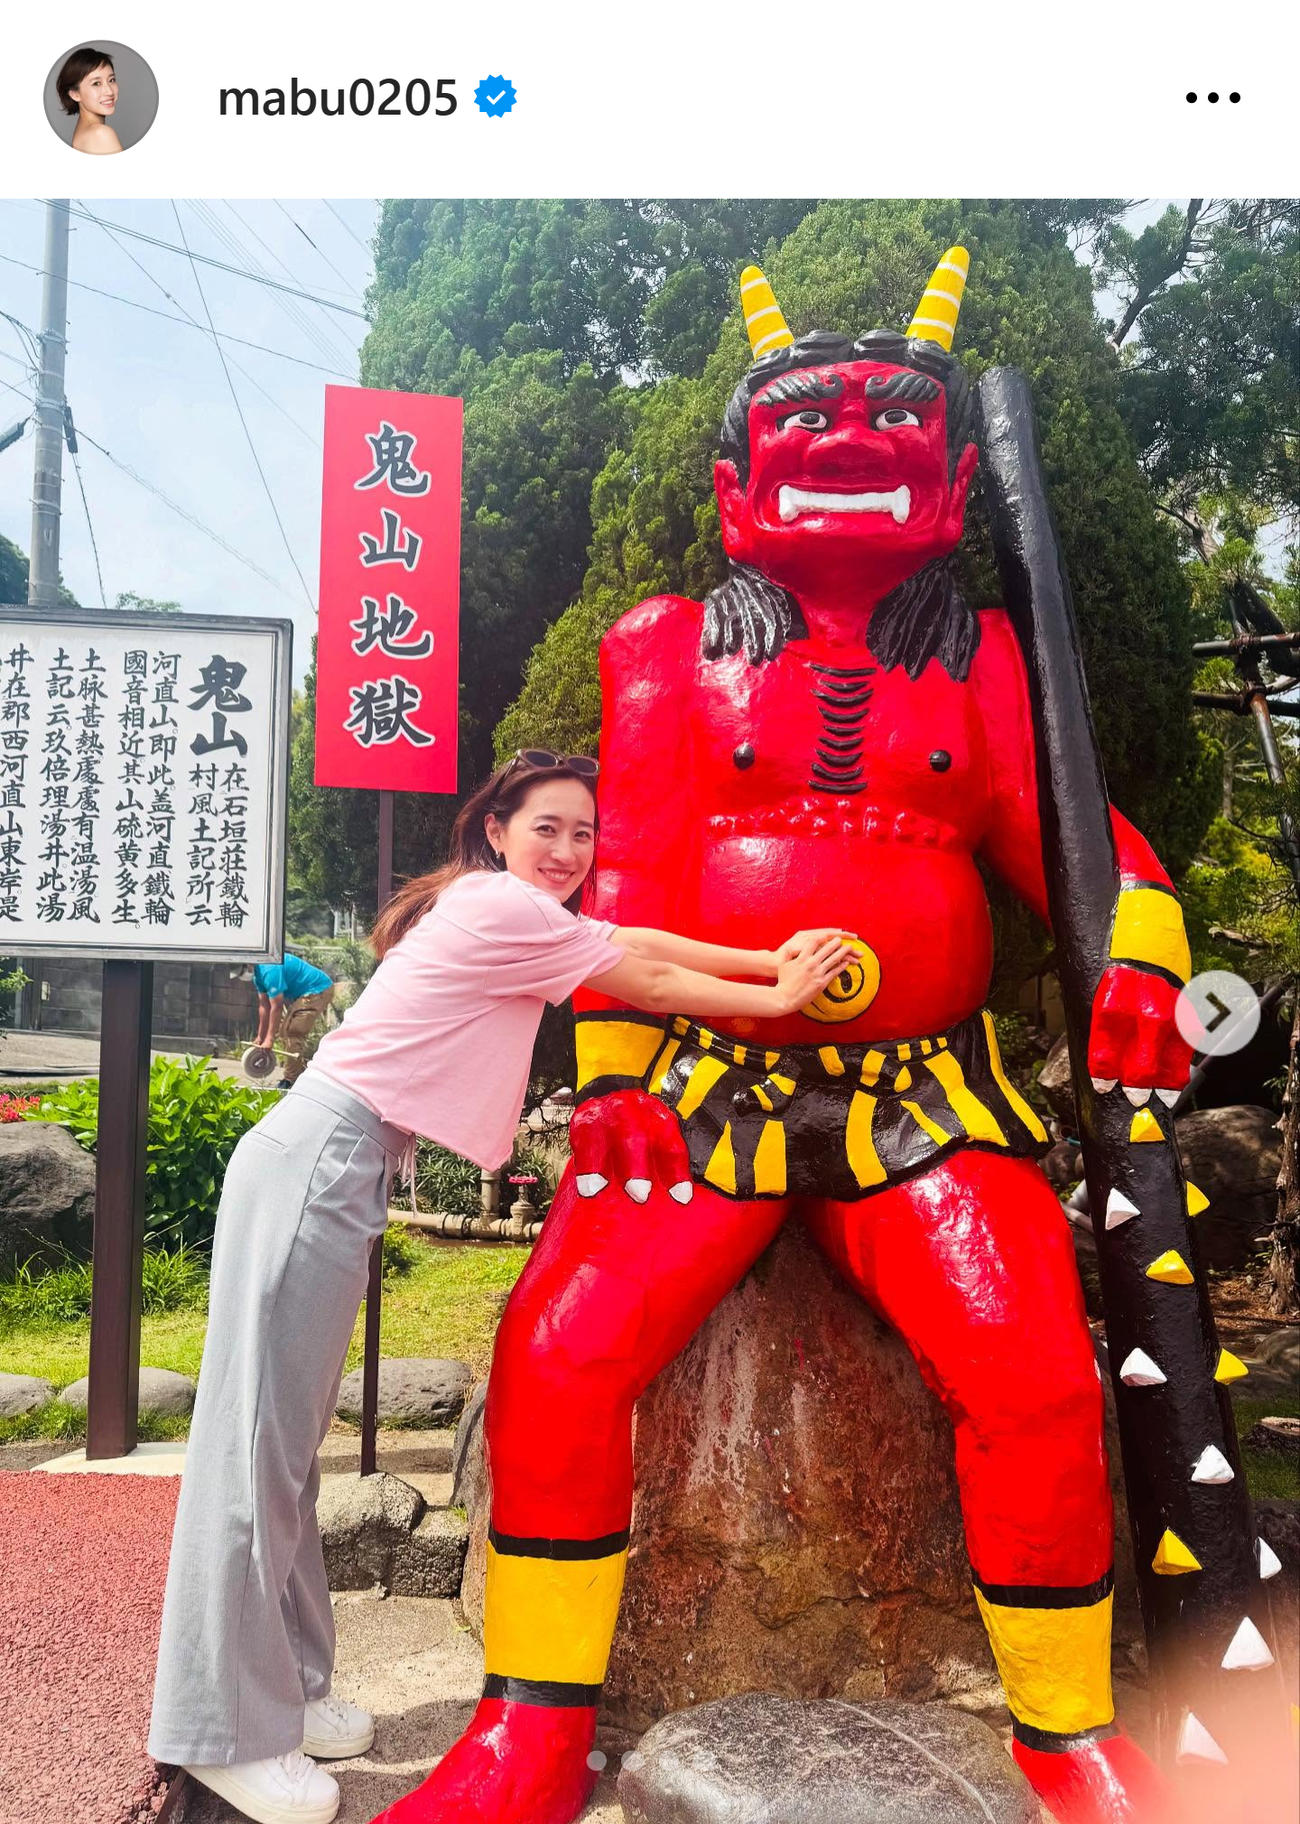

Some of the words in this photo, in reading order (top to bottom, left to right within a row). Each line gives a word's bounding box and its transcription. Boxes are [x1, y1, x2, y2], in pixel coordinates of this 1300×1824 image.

[344, 420, 435, 748] 鬼山地獄
[187, 655, 252, 757] 鬼山
[185, 763, 219, 926] 村風土記所云
